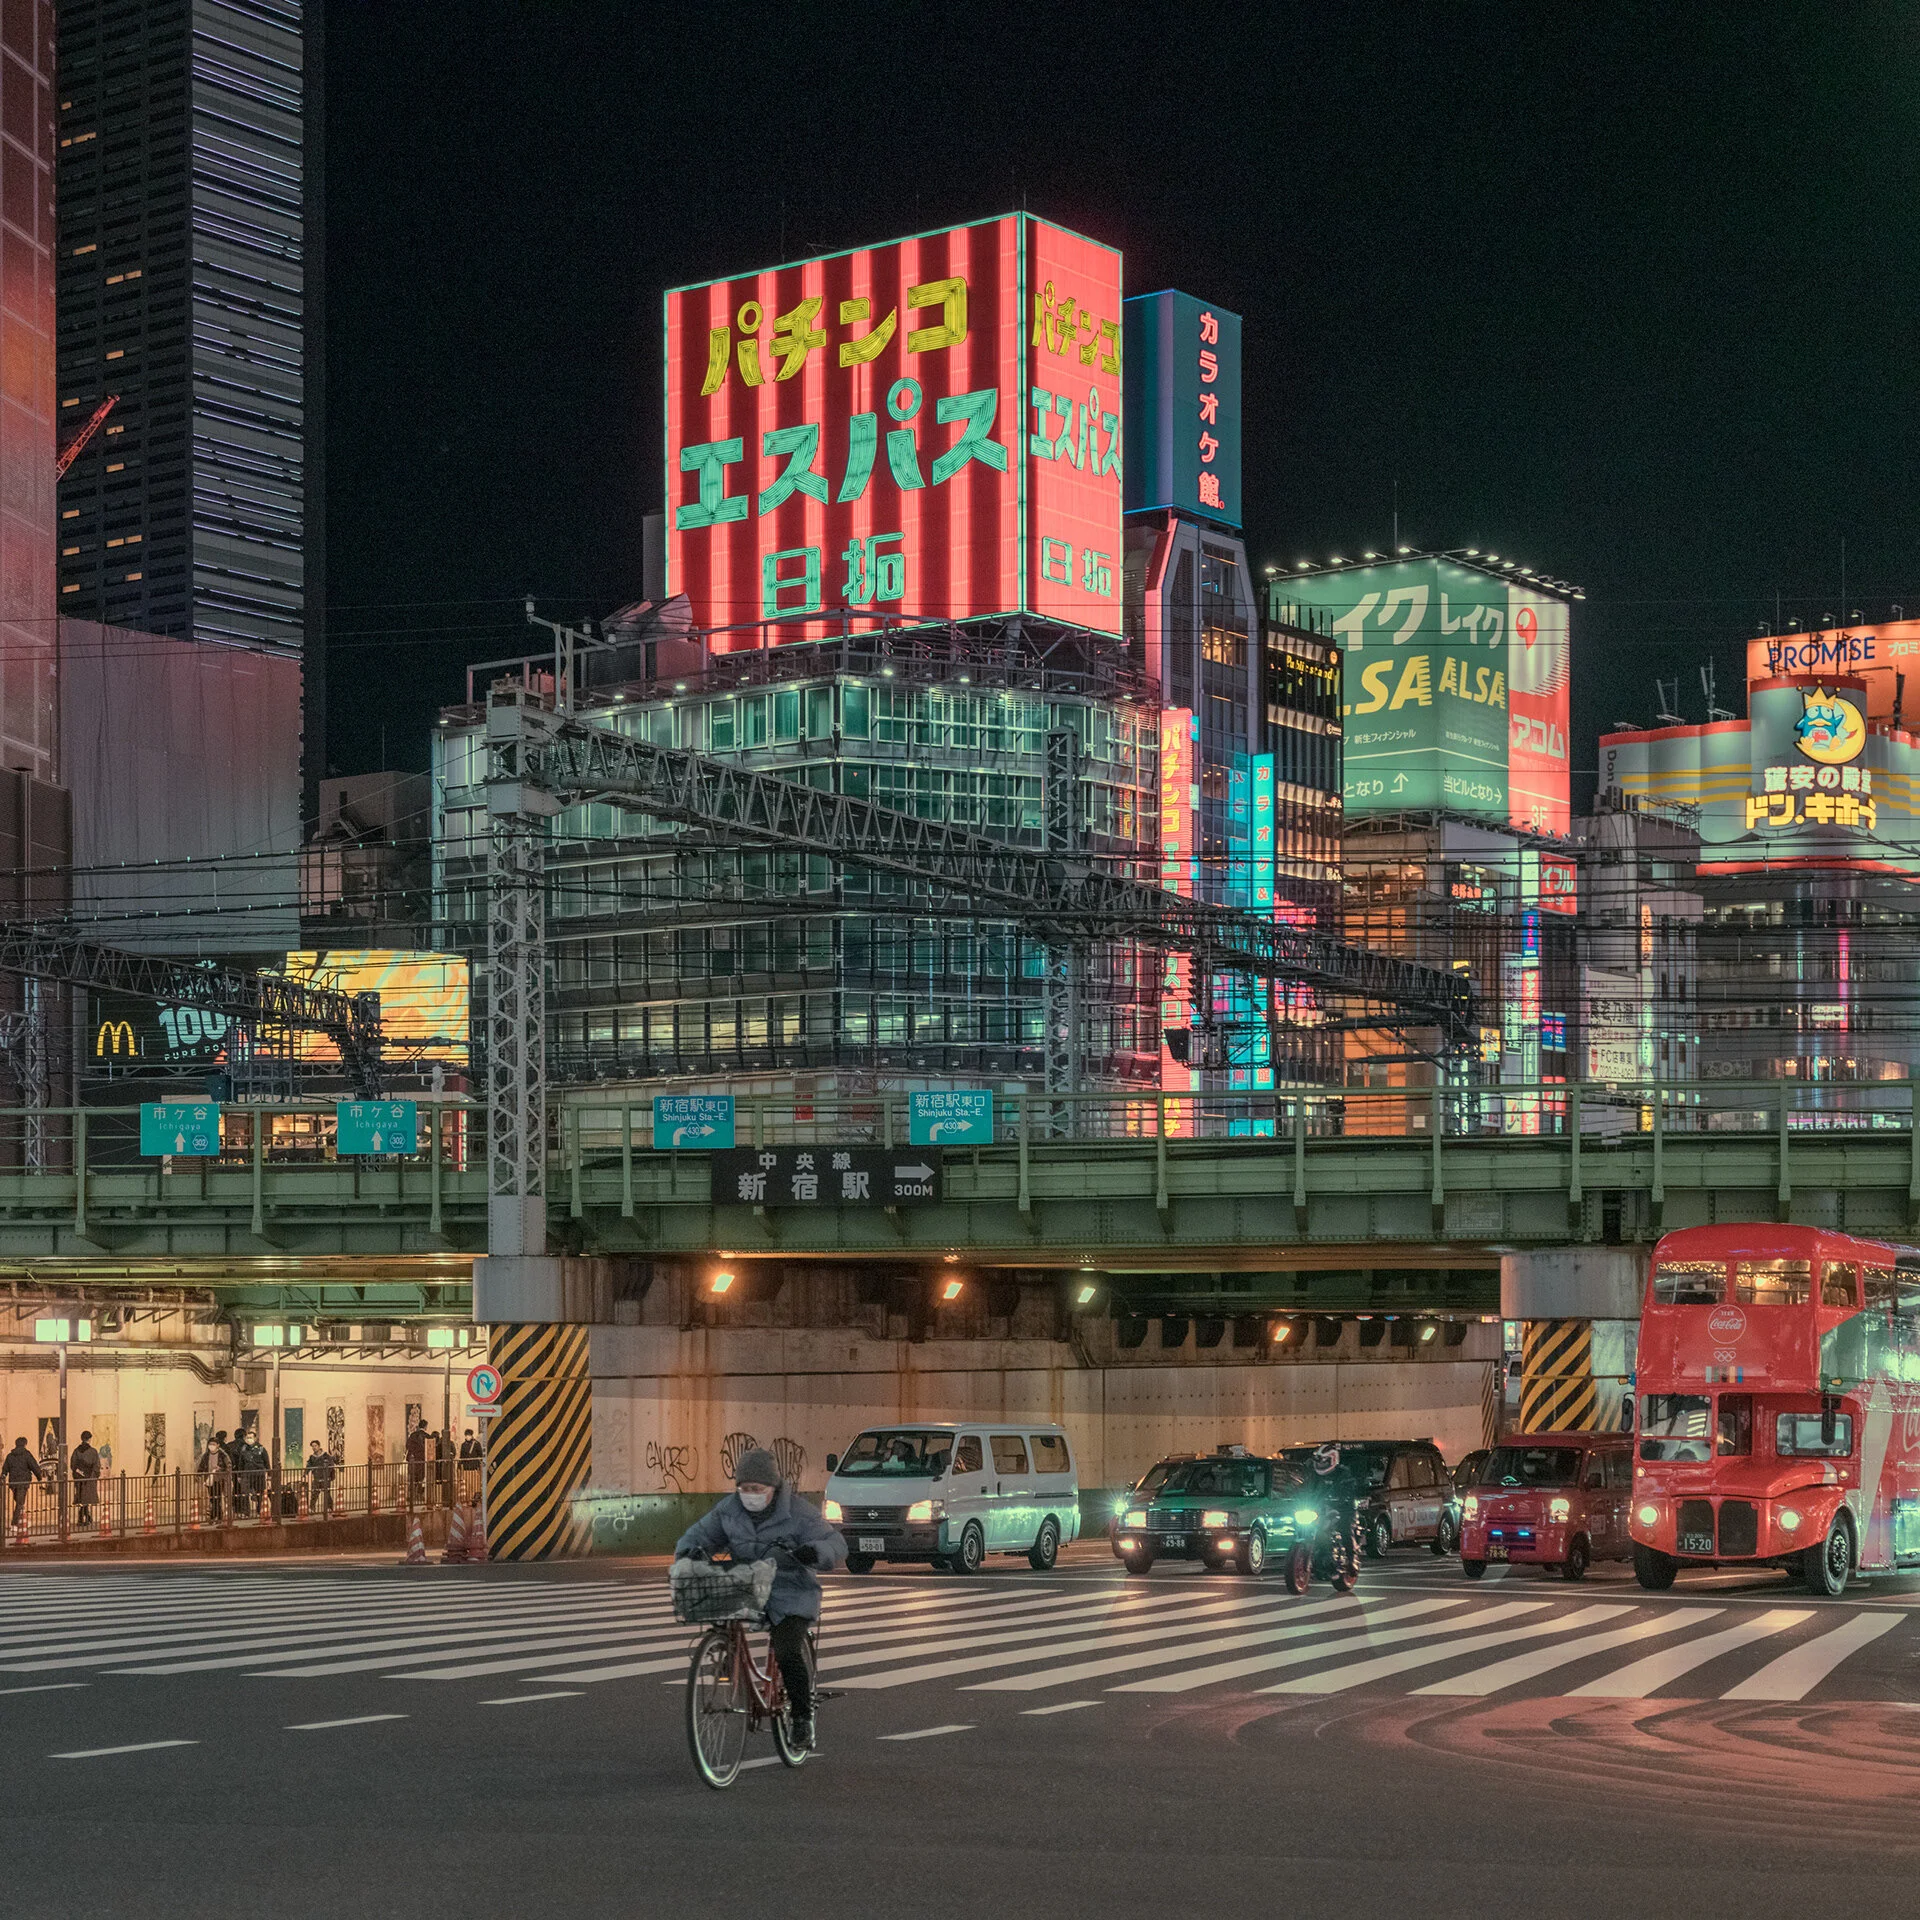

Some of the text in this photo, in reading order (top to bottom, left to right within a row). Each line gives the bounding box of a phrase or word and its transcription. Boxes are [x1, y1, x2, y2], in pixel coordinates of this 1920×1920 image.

[700, 275, 968, 397] パチンコ
[1031, 280, 1121, 377] パチンコ
[1030, 385, 1122, 482] エスパス
[675, 376, 1009, 532] エスパス
[762, 531, 906, 618] 日拓
[1041, 536, 1112, 599] 日拓
[1440, 592, 1505, 650] レイク
[1769, 636, 1876, 671] PROMISE
[1438, 656, 1506, 710] ALSA
[1512, 713, 1565, 759] アコム
[1161, 723, 1181, 834] パチンコ
[1606, 749, 1617, 783] Don
[1443, 775, 1494, 802] 当ビルとなり
[1764, 765, 1872, 795] 驚安の殿堂
[1530, 805, 1548, 828] 3F
[659, 1098, 729, 1113] 新宿駅東口
[914, 1094, 986, 1109] 新宿駅東口
[918, 1108, 953, 1118] Shinjuku
[158, 1122, 202, 1132] Ichigaya
[355, 1120, 399, 1130] Ichigaya
[662, 1113, 697, 1123] Shinjuku
[687, 1125, 700, 1136] 430
[943, 1120, 957, 1131] 430
[193, 1137, 207, 1148] 302
[390, 1135, 404, 1146] 302
[758, 1152, 852, 1171] 中央線
[738, 1172, 871, 1201] 新宿駅
[894, 1184, 933, 1197] 300M
[1710, 1318, 1743, 1330] Coca-Cola
[1684, 1538, 1712, 1551] 15-20
